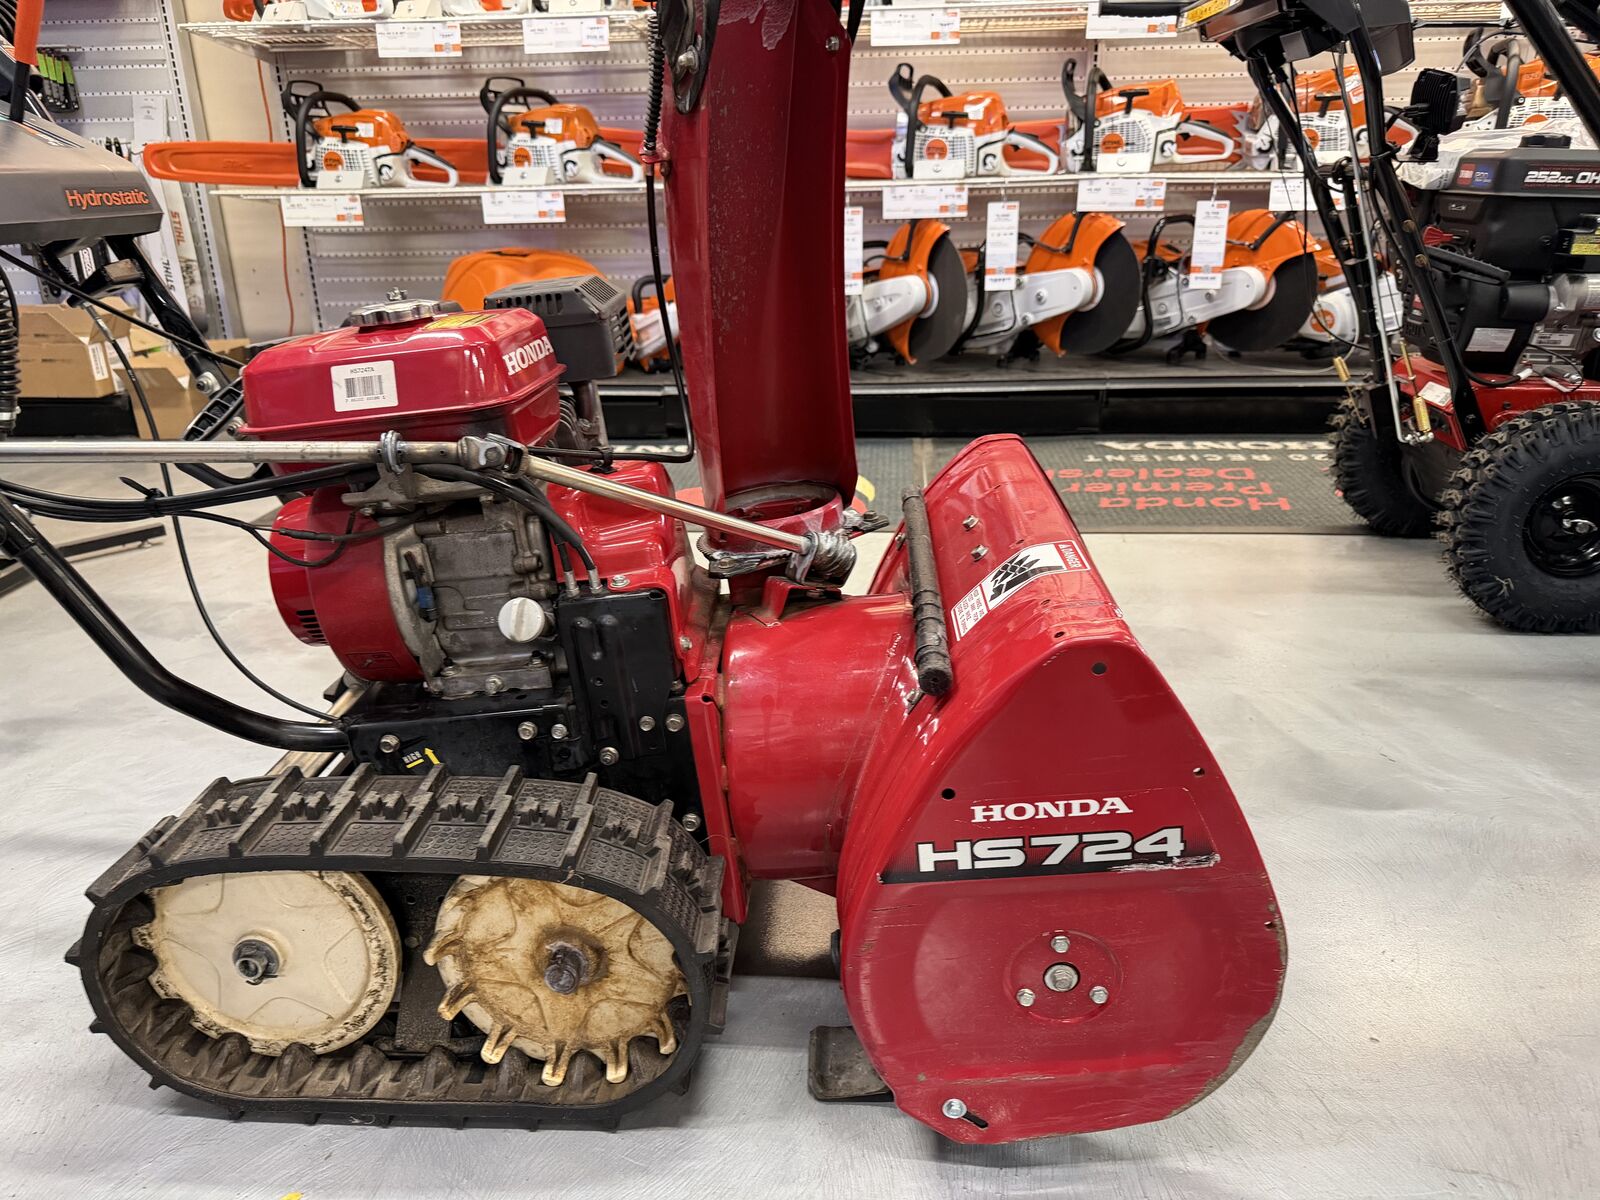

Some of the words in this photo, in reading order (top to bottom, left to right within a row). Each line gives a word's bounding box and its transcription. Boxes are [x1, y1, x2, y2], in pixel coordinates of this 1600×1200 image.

[1524, 171, 1574, 184] 252cc
[65, 188, 149, 210] Hydrostatic
[170, 210, 185, 245] STIHL
[162, 259, 176, 292] STIHL
[502, 335, 555, 375] HONDA
[1098, 440, 1334, 451] HONDA
[1084, 453, 1273, 463] RECIPIENT
[1061, 481, 1273, 496] Premier
[1099, 496, 1291, 511] Honda
[402, 750, 422, 764] HIGH
[970, 797, 1134, 823] HONDA
